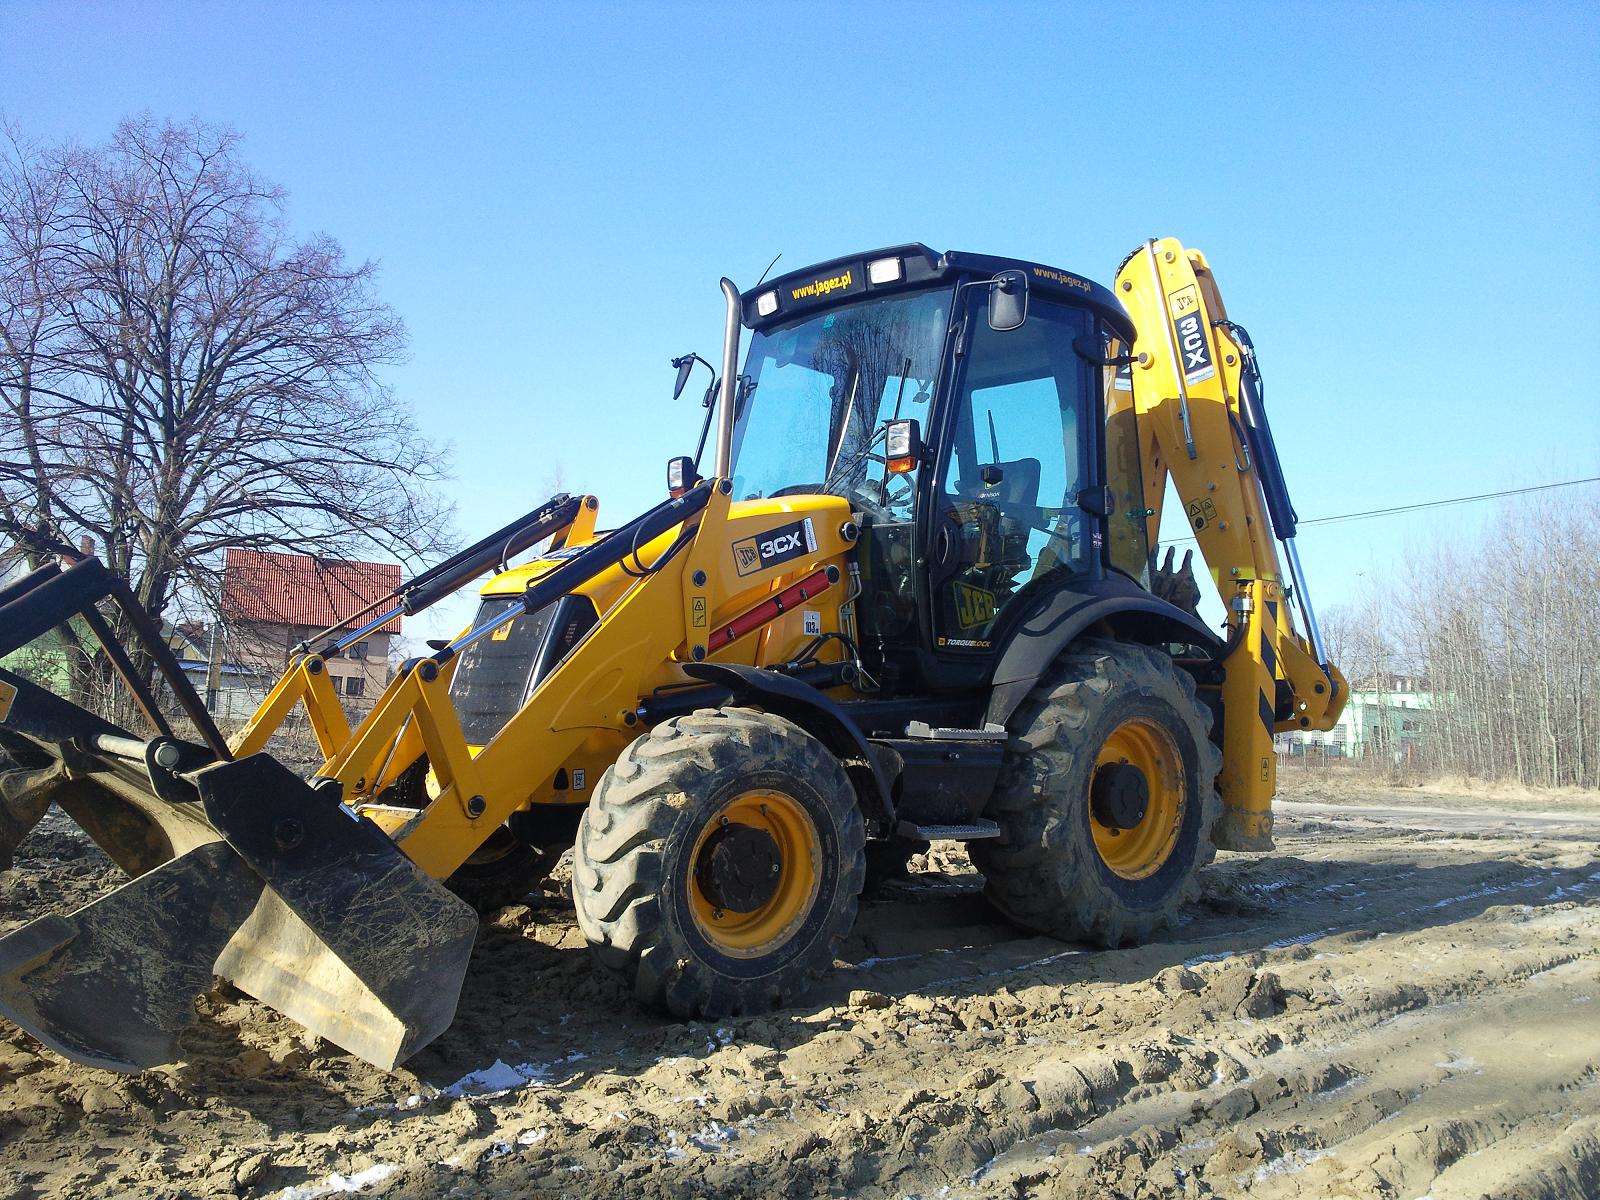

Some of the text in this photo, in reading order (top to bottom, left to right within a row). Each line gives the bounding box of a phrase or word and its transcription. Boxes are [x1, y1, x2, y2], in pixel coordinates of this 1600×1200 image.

[791, 270, 852, 300] www.jagez.pl
[1033, 267, 1091, 292] www.jagez.pl
[1180, 316, 1208, 369] 3CX
[737, 547, 758, 567] JCB
[760, 530, 802, 559] 3CX
[959, 585, 994, 625] JCB
[805, 621, 816, 634] 103
